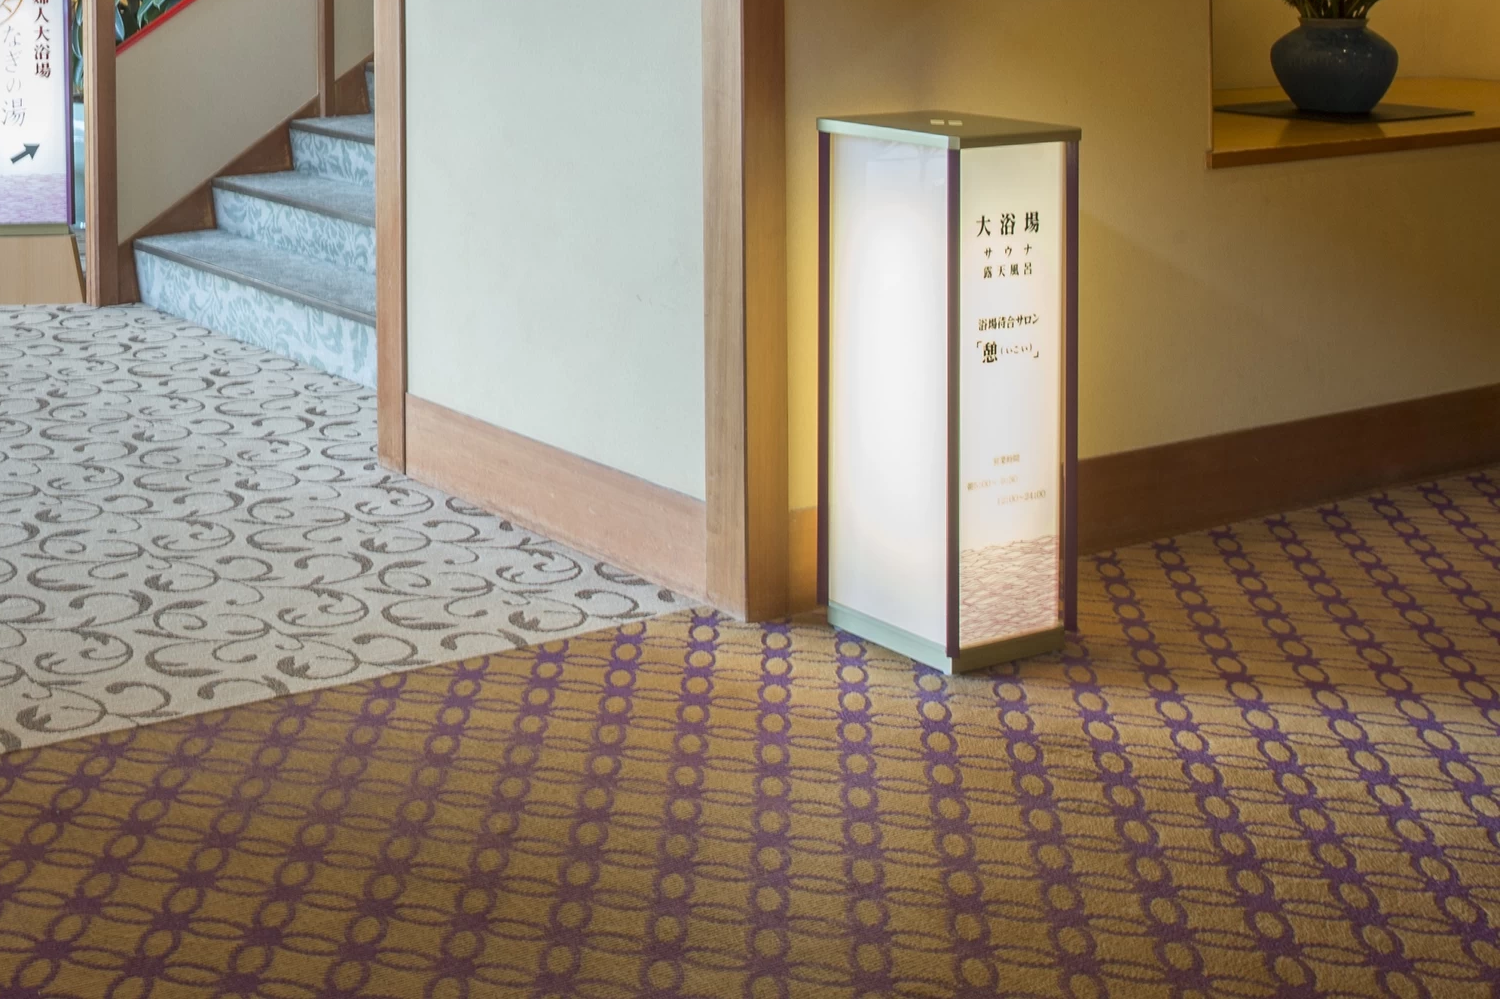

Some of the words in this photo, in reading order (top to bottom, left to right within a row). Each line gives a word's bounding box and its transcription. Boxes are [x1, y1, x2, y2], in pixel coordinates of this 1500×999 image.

[976, 210, 1041, 238] 大浴場
[984, 243, 1033, 259] サウナ
[983, 261, 1033, 280] 露天風呂
